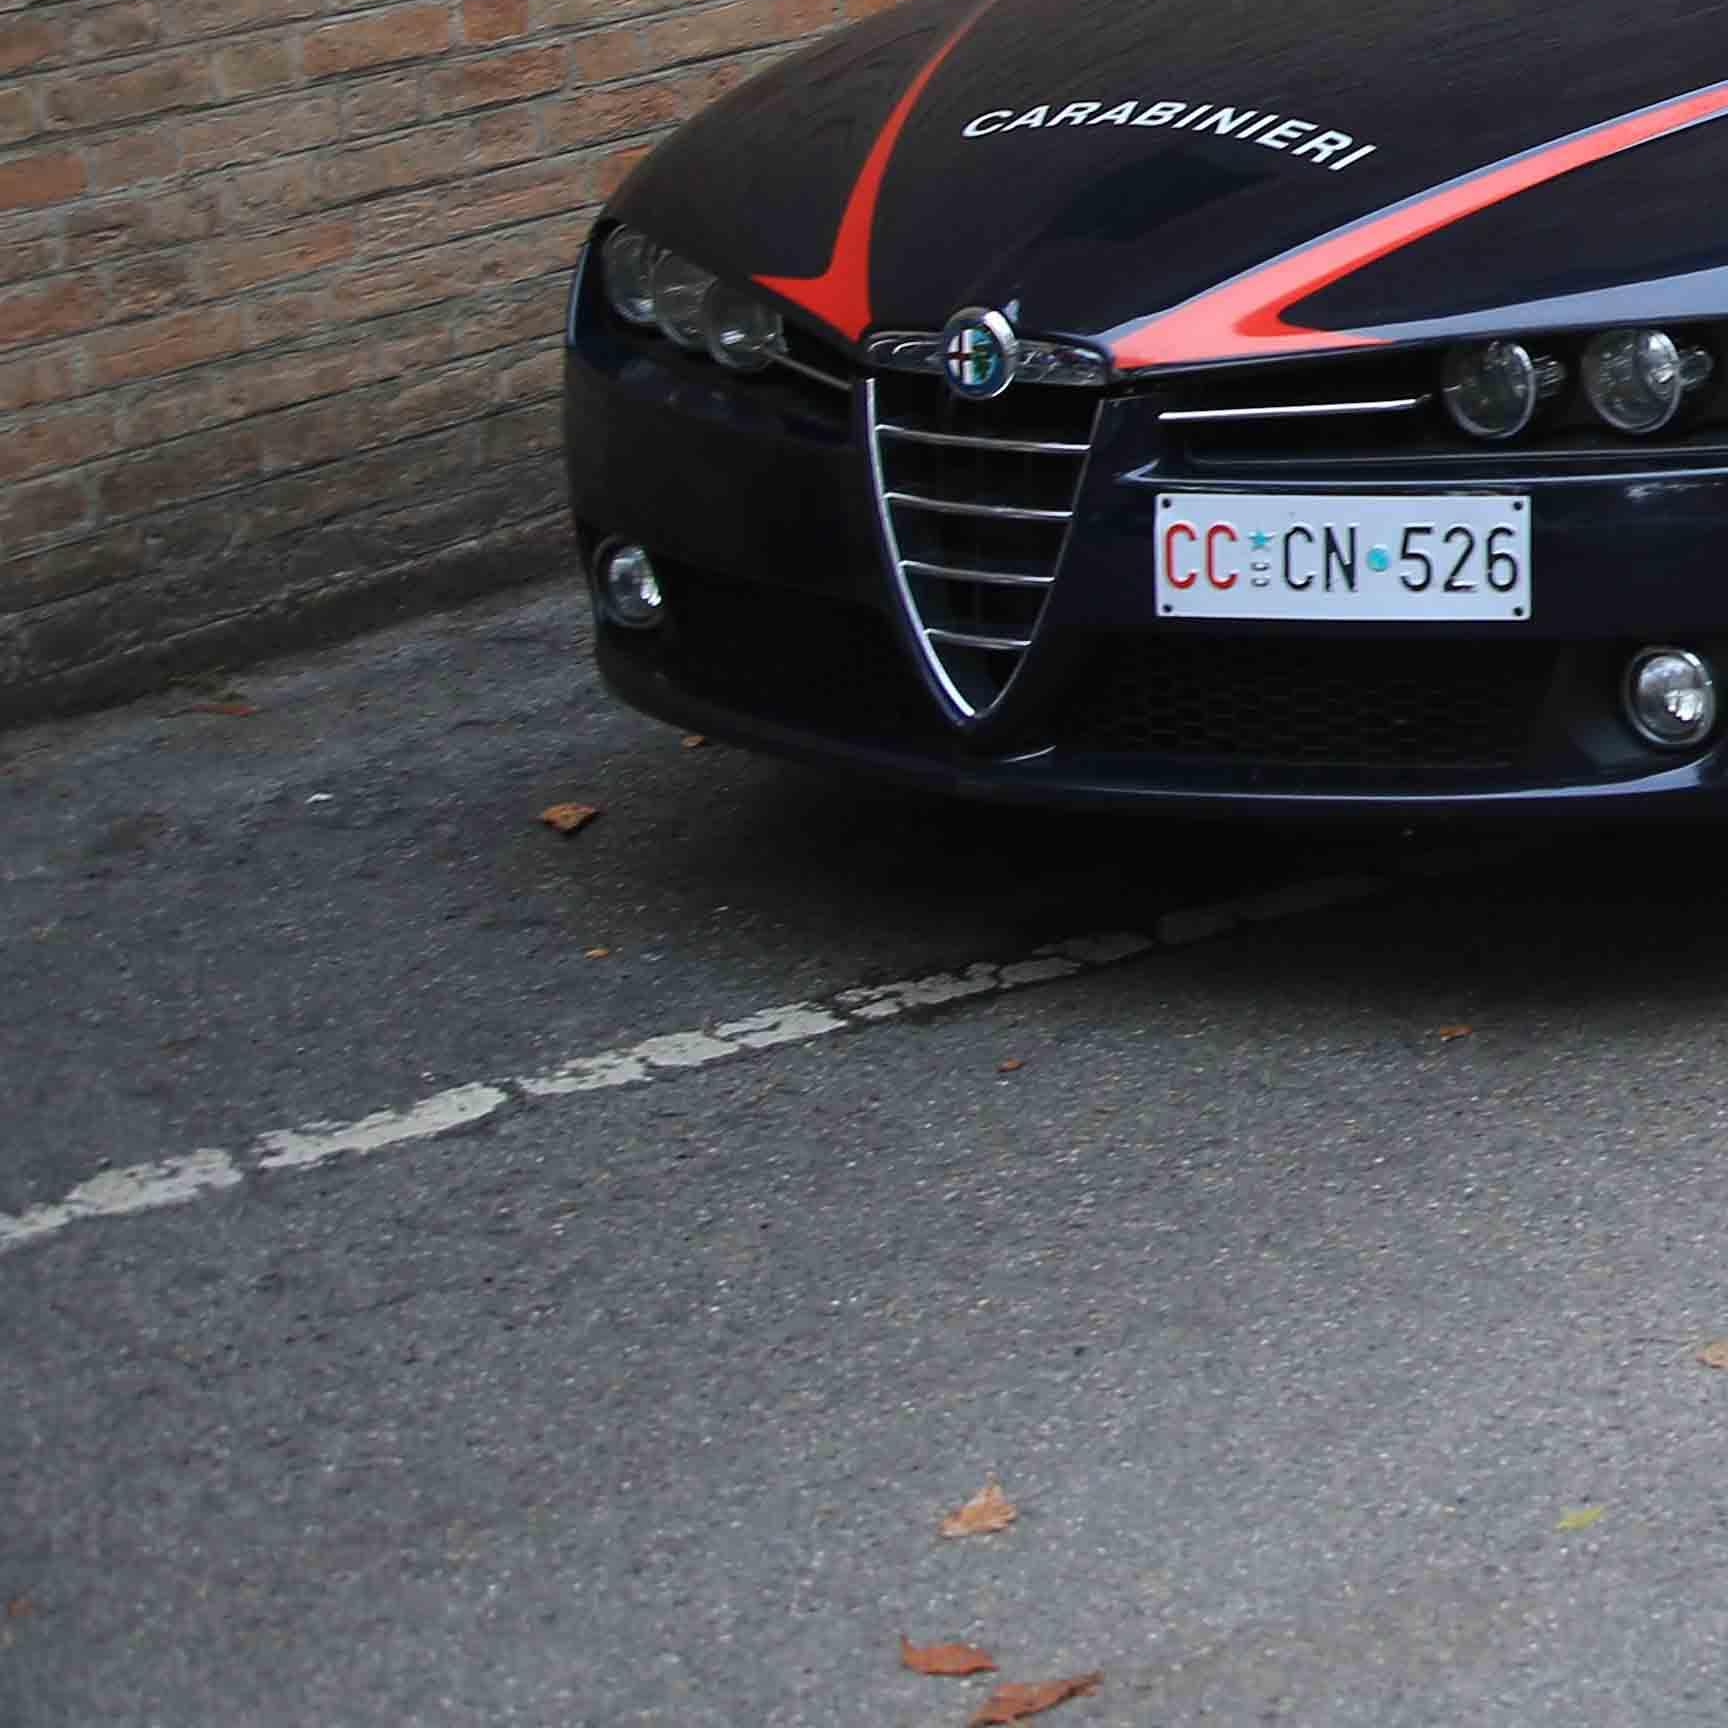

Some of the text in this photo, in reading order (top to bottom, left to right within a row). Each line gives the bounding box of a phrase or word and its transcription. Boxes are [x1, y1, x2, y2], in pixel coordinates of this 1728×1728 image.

[961, 101, 1377, 171] CARABINIERI
[1162, 522, 1519, 593] CC CN 526
